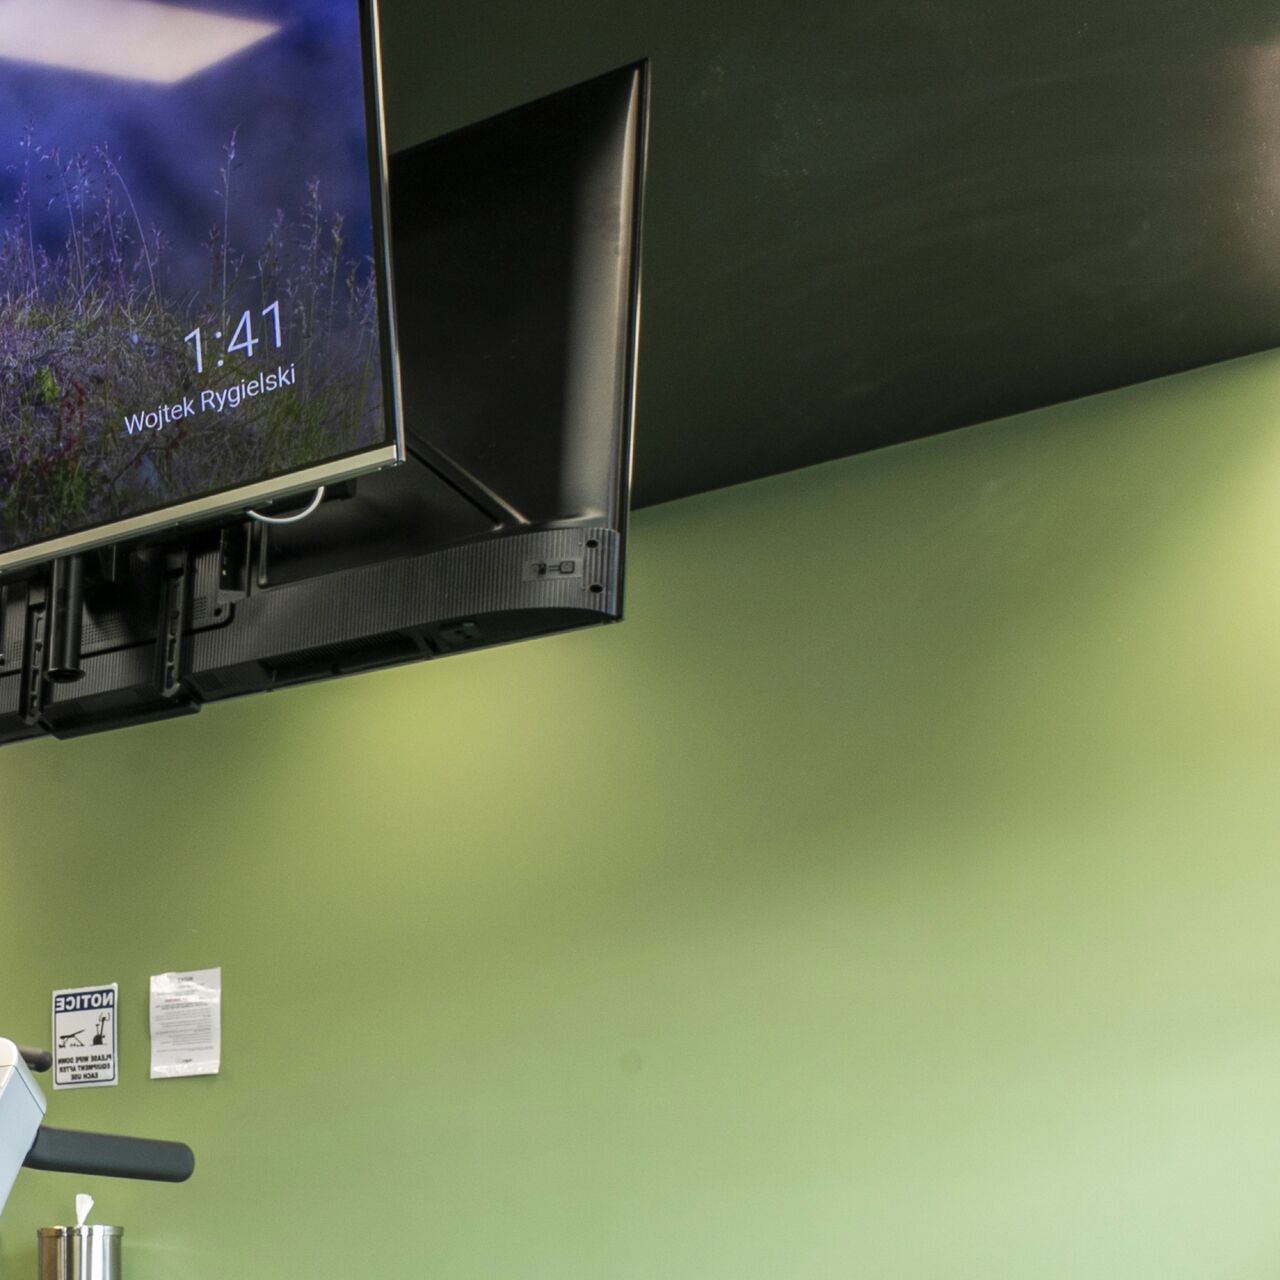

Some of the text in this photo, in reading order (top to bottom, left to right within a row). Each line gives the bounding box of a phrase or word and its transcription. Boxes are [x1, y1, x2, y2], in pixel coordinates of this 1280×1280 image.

[183, 300, 282, 374] 1:41
[123, 363, 296, 435] Wojtek Rygielski
